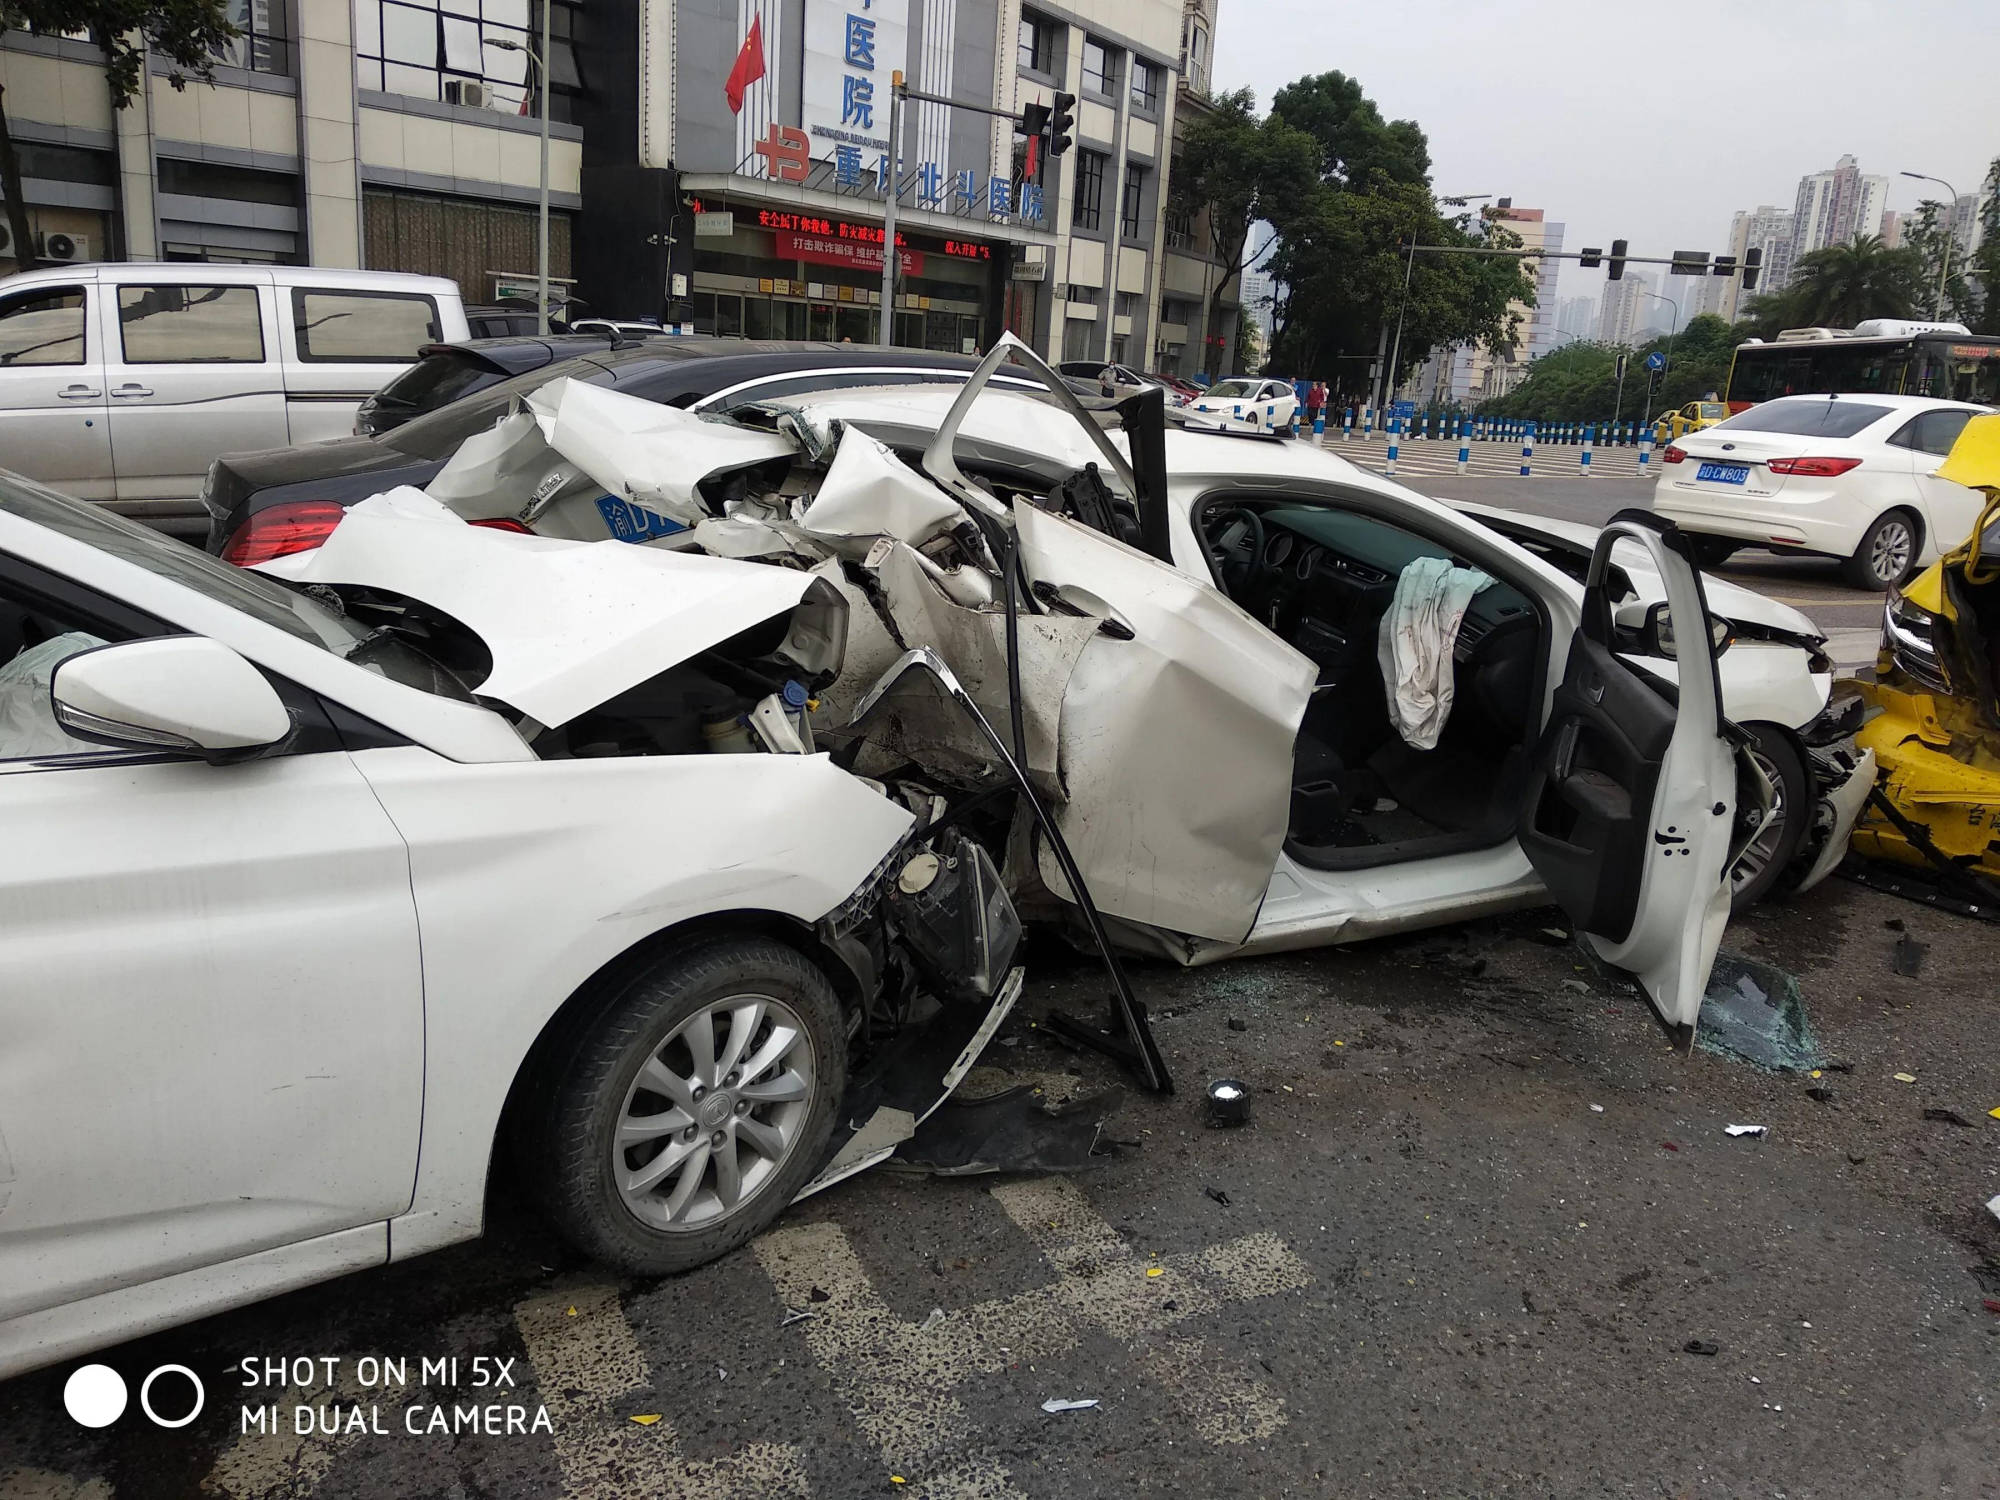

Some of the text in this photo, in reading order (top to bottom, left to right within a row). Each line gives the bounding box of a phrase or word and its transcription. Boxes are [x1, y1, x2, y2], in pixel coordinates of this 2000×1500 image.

[842, 0, 877, 130] 医院
[833, 143, 1044, 222] 重庆北斗医院
